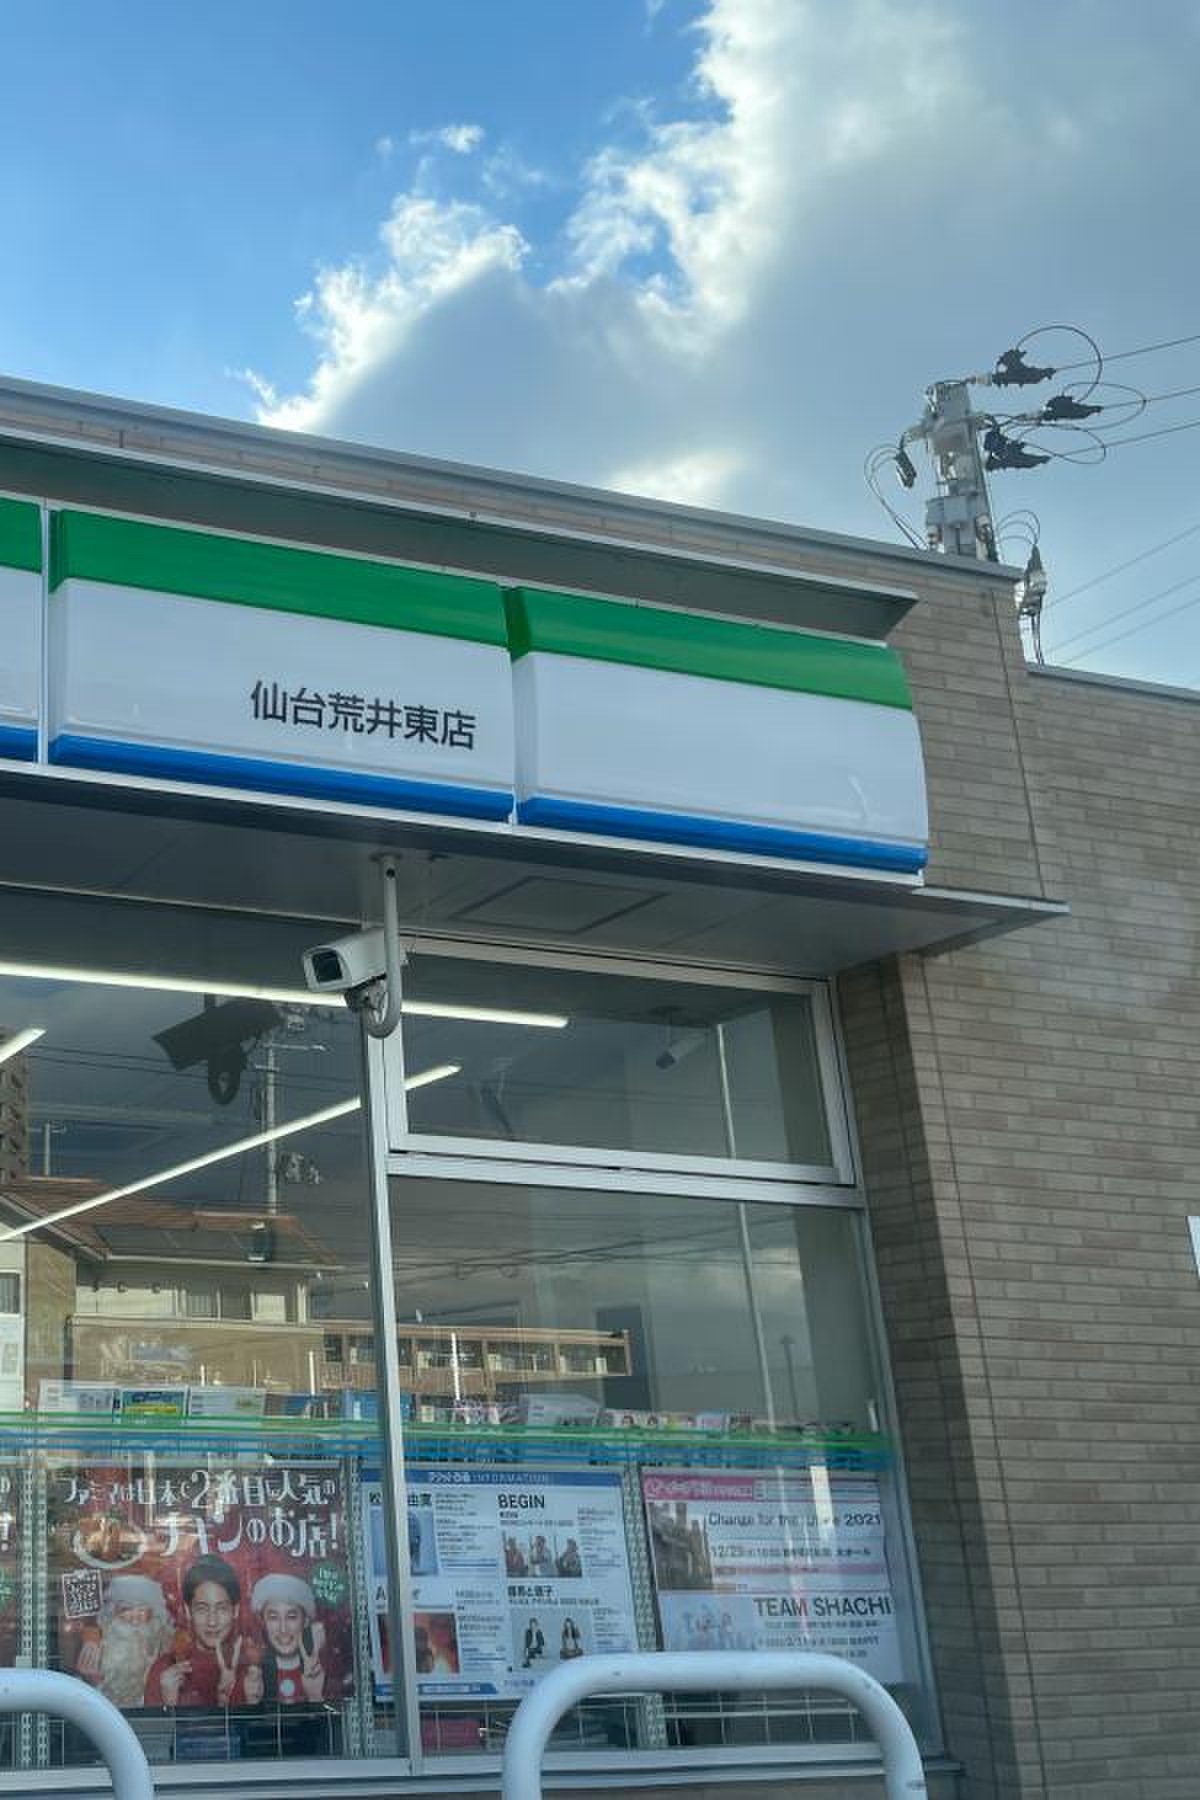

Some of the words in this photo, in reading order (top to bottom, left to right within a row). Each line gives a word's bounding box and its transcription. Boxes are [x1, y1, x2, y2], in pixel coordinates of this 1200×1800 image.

[250, 680, 477, 750] 仙台荒井東店
[497, 1493, 546, 1510] BEGIN
[752, 1597, 808, 1617] TEAM
[814, 1596, 892, 1617] SHACHI
